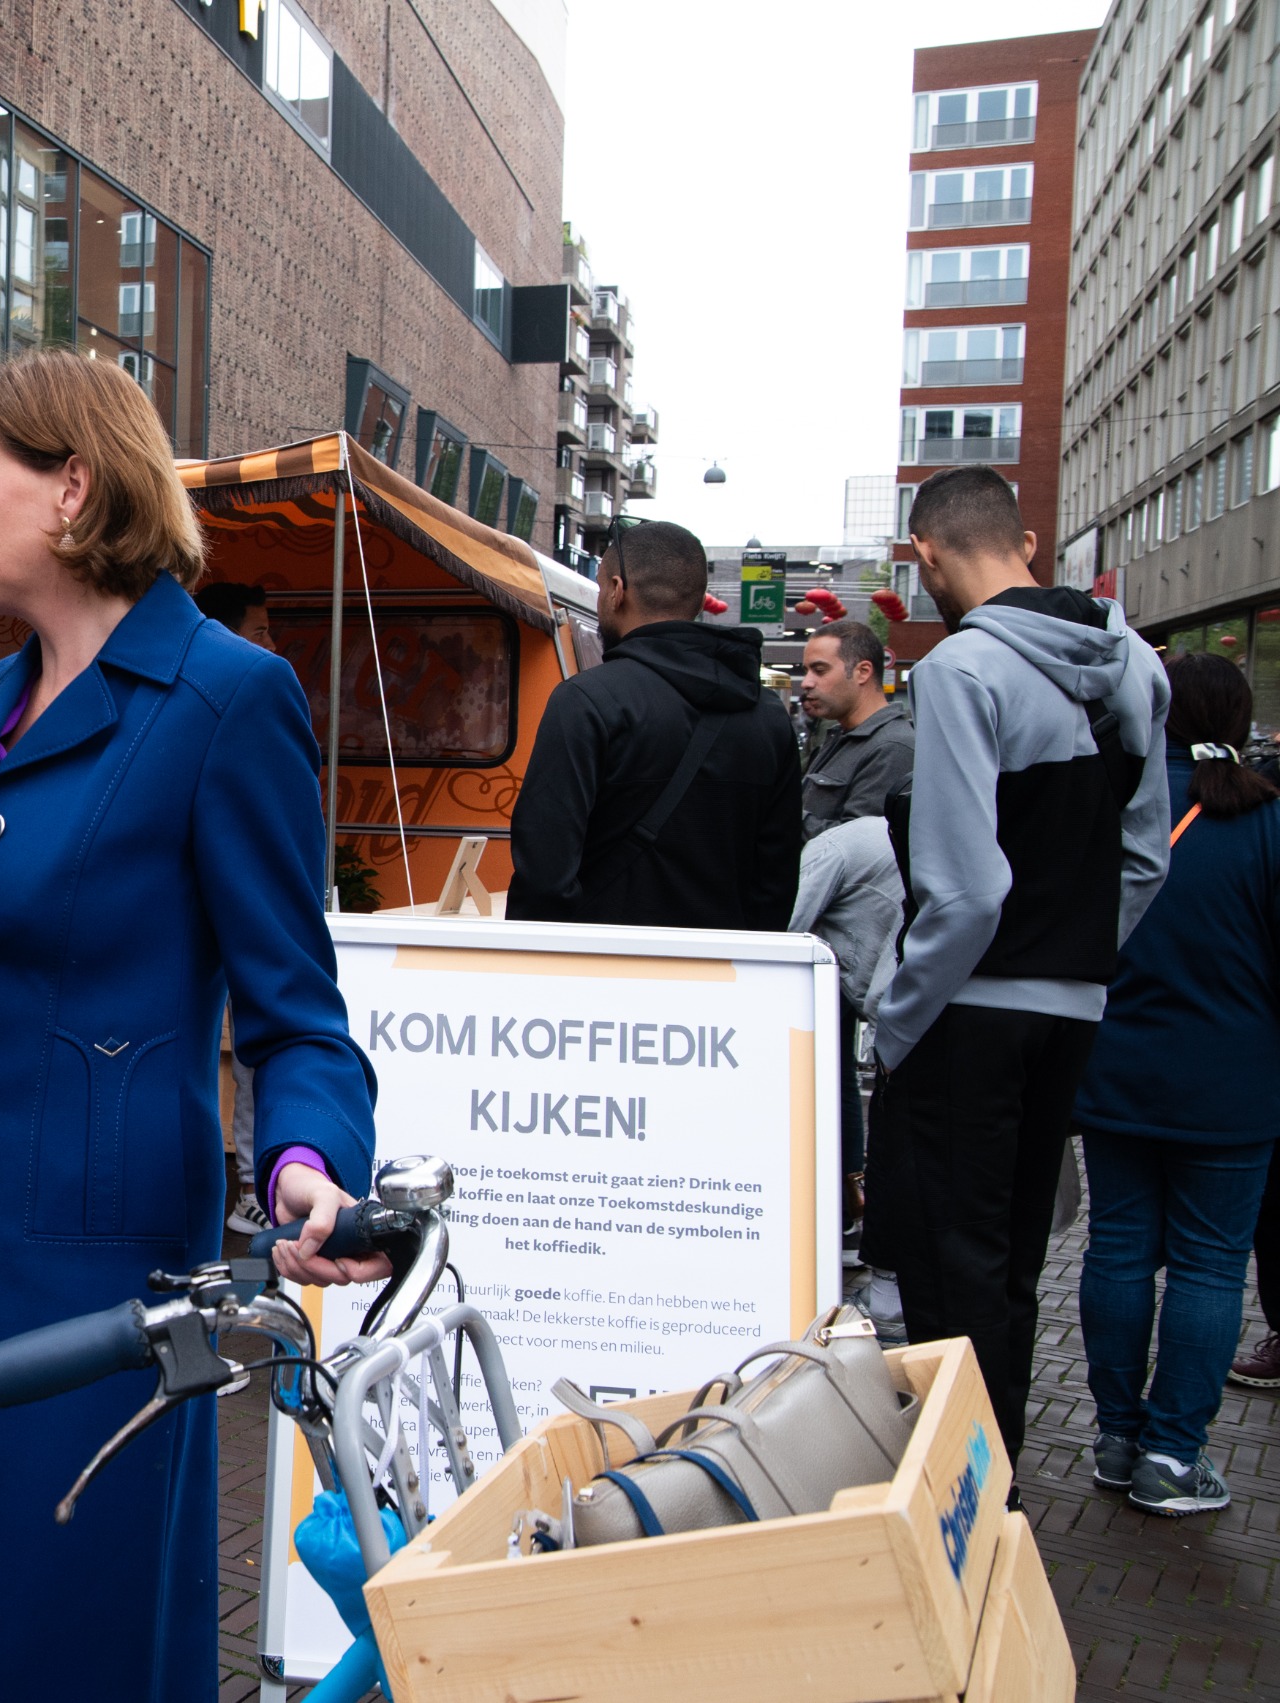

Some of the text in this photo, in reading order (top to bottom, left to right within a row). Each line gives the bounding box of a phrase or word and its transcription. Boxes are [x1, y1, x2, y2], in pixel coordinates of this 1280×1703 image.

[368, 1010, 740, 1070] KOM KOFFIEDIK
[469, 1089, 647, 1142] KIJKEN!
[480, 1166, 494, 1181] je
[497, 1168, 569, 1182] toekomst
[572, 1172, 608, 1184] eruit
[611, 1175, 644, 1189] gaat
[647, 1175, 686, 1188] zien?
[689, 1177, 731, 1191] Drink
[734, 1182, 762, 1193] een
[459, 1187, 503, 1202] koffie
[506, 1194, 524, 1204] en
[528, 1192, 556, 1205] laat
[559, 1196, 595, 1207] onze
[598, 1196, 764, 1220] Toekomstdeskundige
[482, 1213, 519, 1226] doen
[522, 1218, 549, 1228] aan
[552, 1216, 571, 1230] de
[574, 1218, 612, 1232] hand
[616, 1224, 643, 1234] van
[646, 1222, 664, 1234] de
[668, 1225, 742, 1240] symbolen
[746, 1227, 760, 1240] in
[505, 1238, 606, 1255] het koffiedik.
[447, 1283, 511, 1300] ntuurlijk
[514, 1287, 562, 1301] goede
[564, 1288, 606, 1304] koffie.
[608, 1292, 626, 1304] En
[628, 1293, 654, 1306] dan
[656, 1294, 708, 1310] hebben
[711, 1301, 731, 1311] we
[733, 1299, 756, 1312] het
[522, 1310, 541, 1322] De
[544, 1311, 605, 1327] lekkerste
[608, 1315, 647, 1330] koffie
[650, 1318, 660, 1330] is
[662, 1320, 761, 1337] geproduceerd
[526, 1336, 558, 1348] voor
[561, 1339, 598, 1351] mens
[600, 1342, 617, 1352] en
[620, 1341, 665, 1355] milieu.
[537, 1405, 549, 1416] in
[477, 1450, 493, 1461] en
